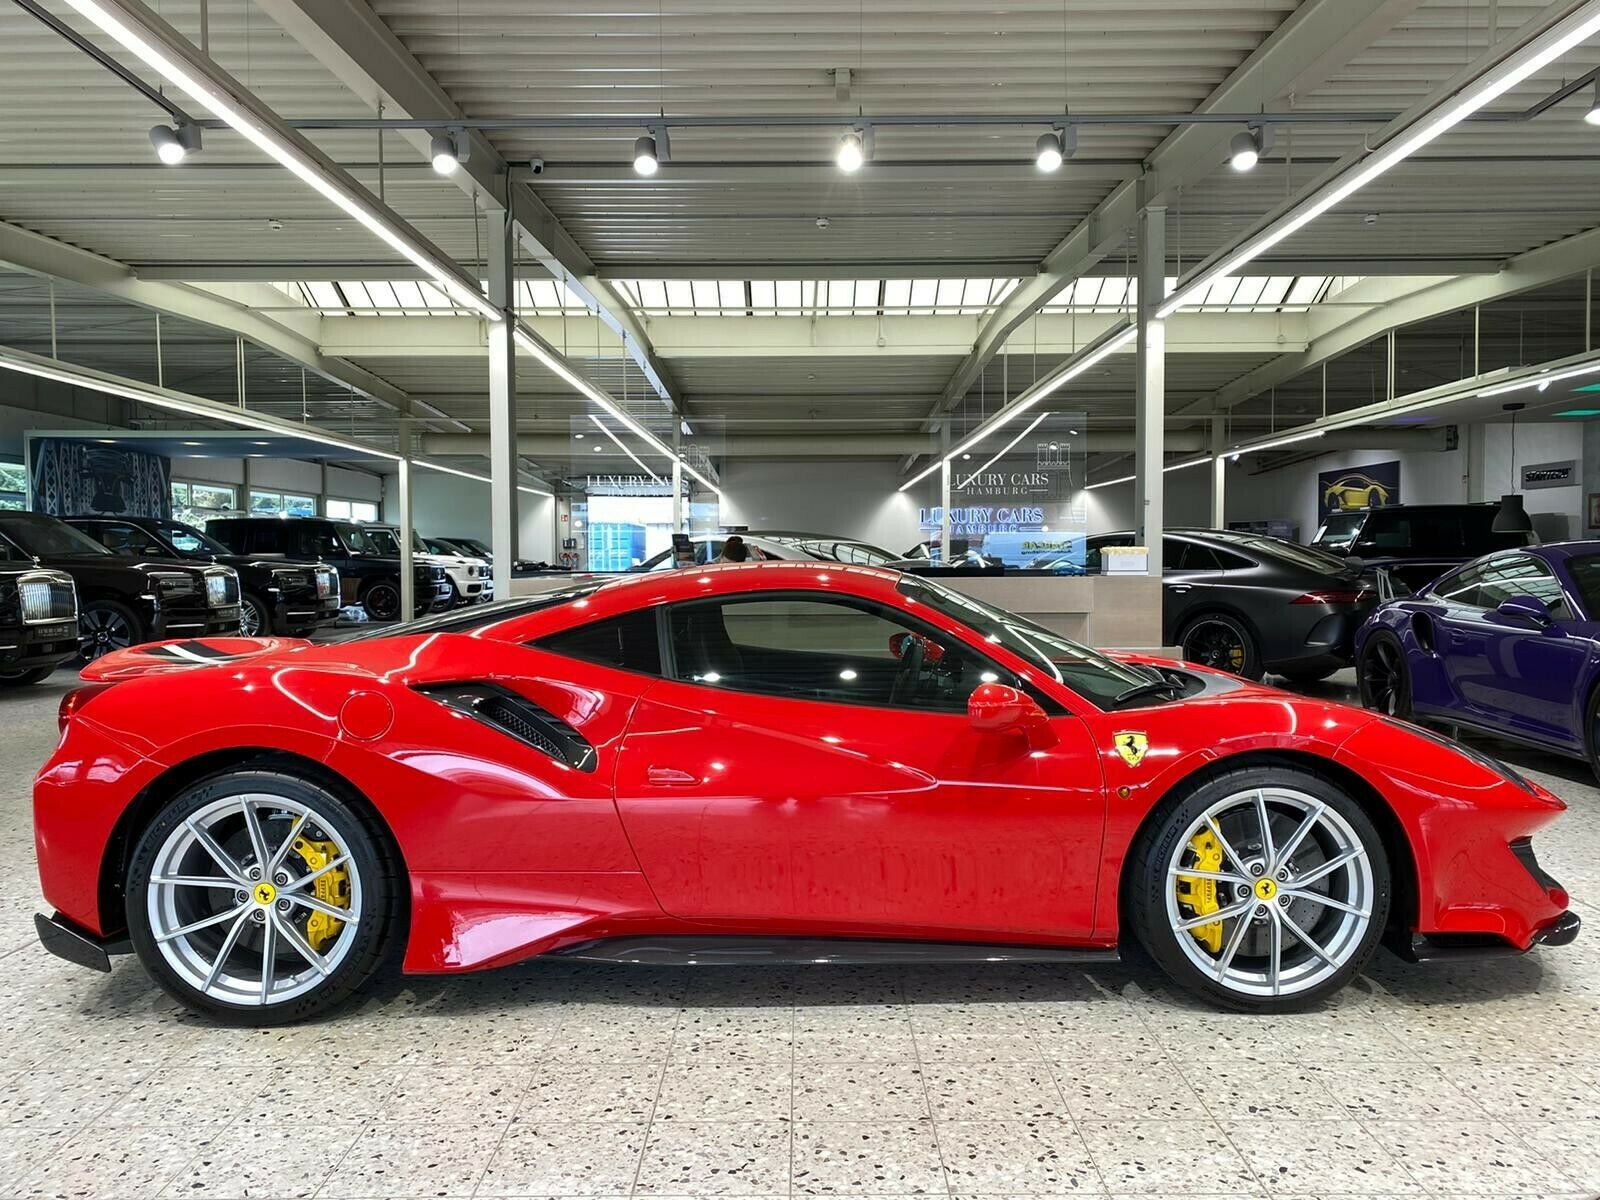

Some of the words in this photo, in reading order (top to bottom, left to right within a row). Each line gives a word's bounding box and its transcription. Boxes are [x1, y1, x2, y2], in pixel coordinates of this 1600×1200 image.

[586, 474, 647, 488] LUXURY
[651, 474, 689, 488] CAS
[1011, 472, 1049, 486] CARS
[967, 487, 1028, 495] HAMBURG
[997, 507, 1044, 523] CARS
